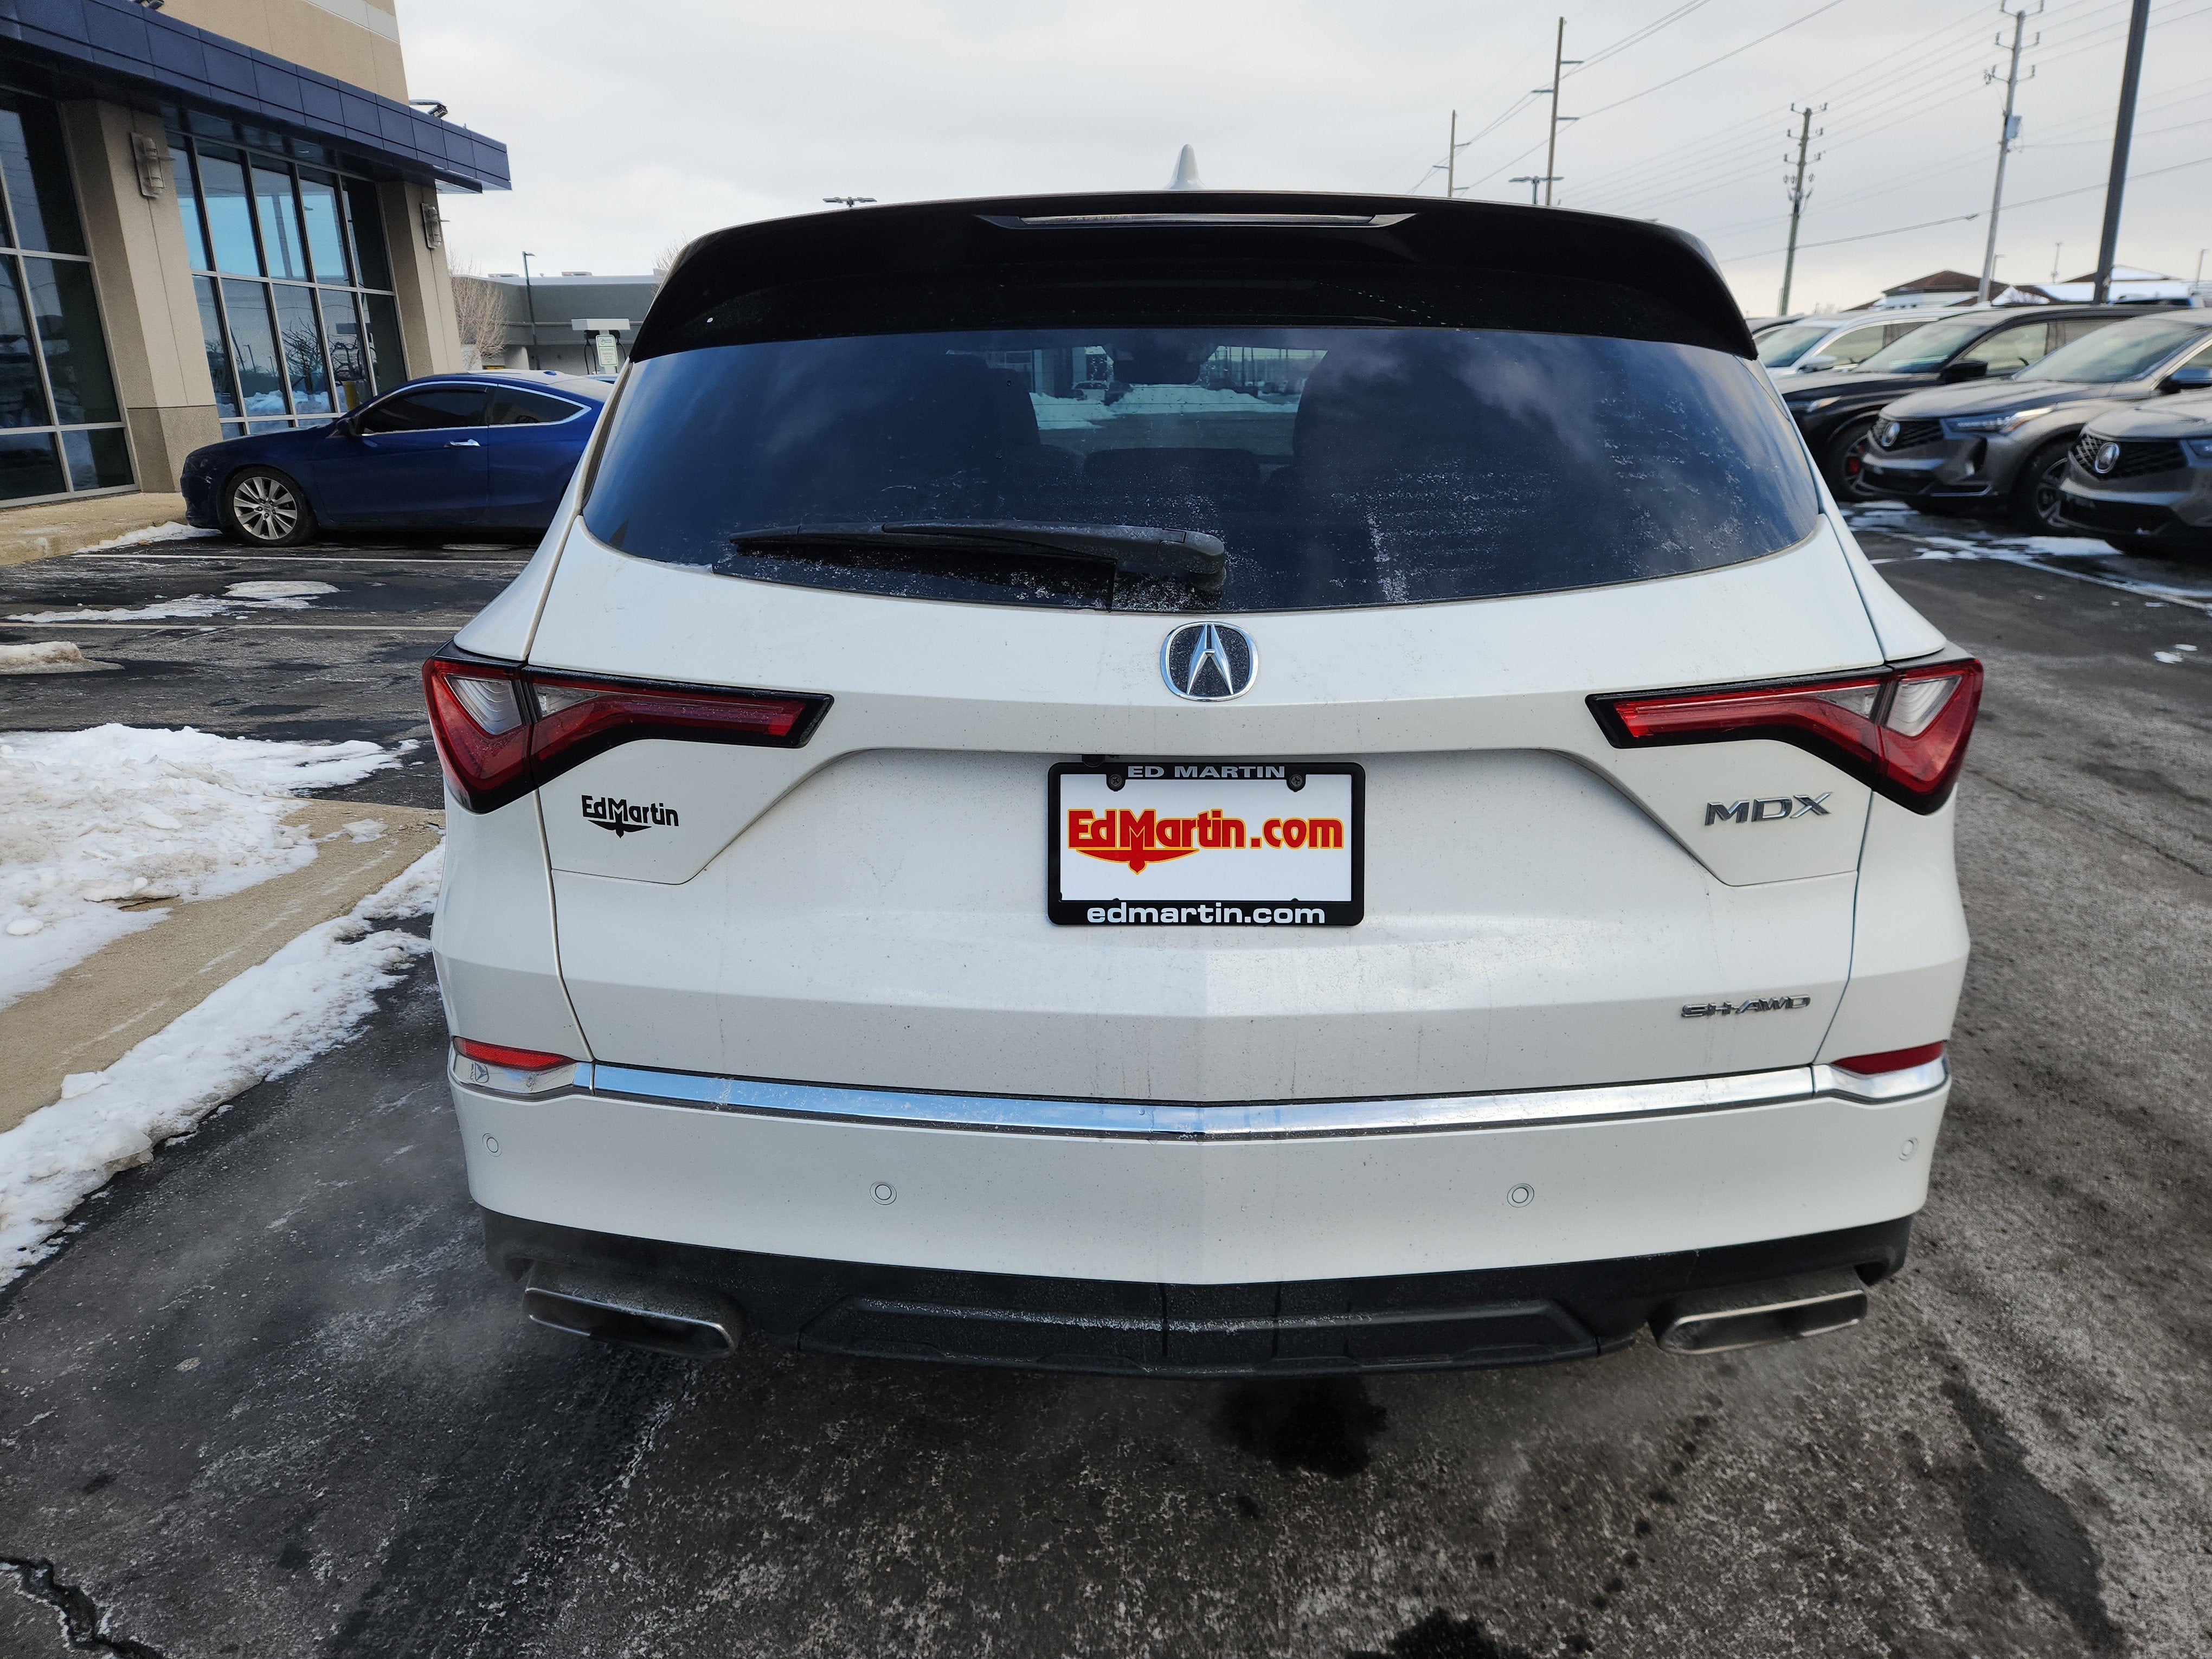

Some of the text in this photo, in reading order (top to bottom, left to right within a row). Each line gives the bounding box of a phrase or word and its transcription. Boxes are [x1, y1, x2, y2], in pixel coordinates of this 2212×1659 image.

[1128, 766, 1285, 778] ED MARTIN
[581, 794, 679, 826] EdMartin
[1705, 792, 1834, 825] MDX
[1068, 808, 1344, 850] EdMartin.com
[1087, 903, 1325, 923] edmartin.com
